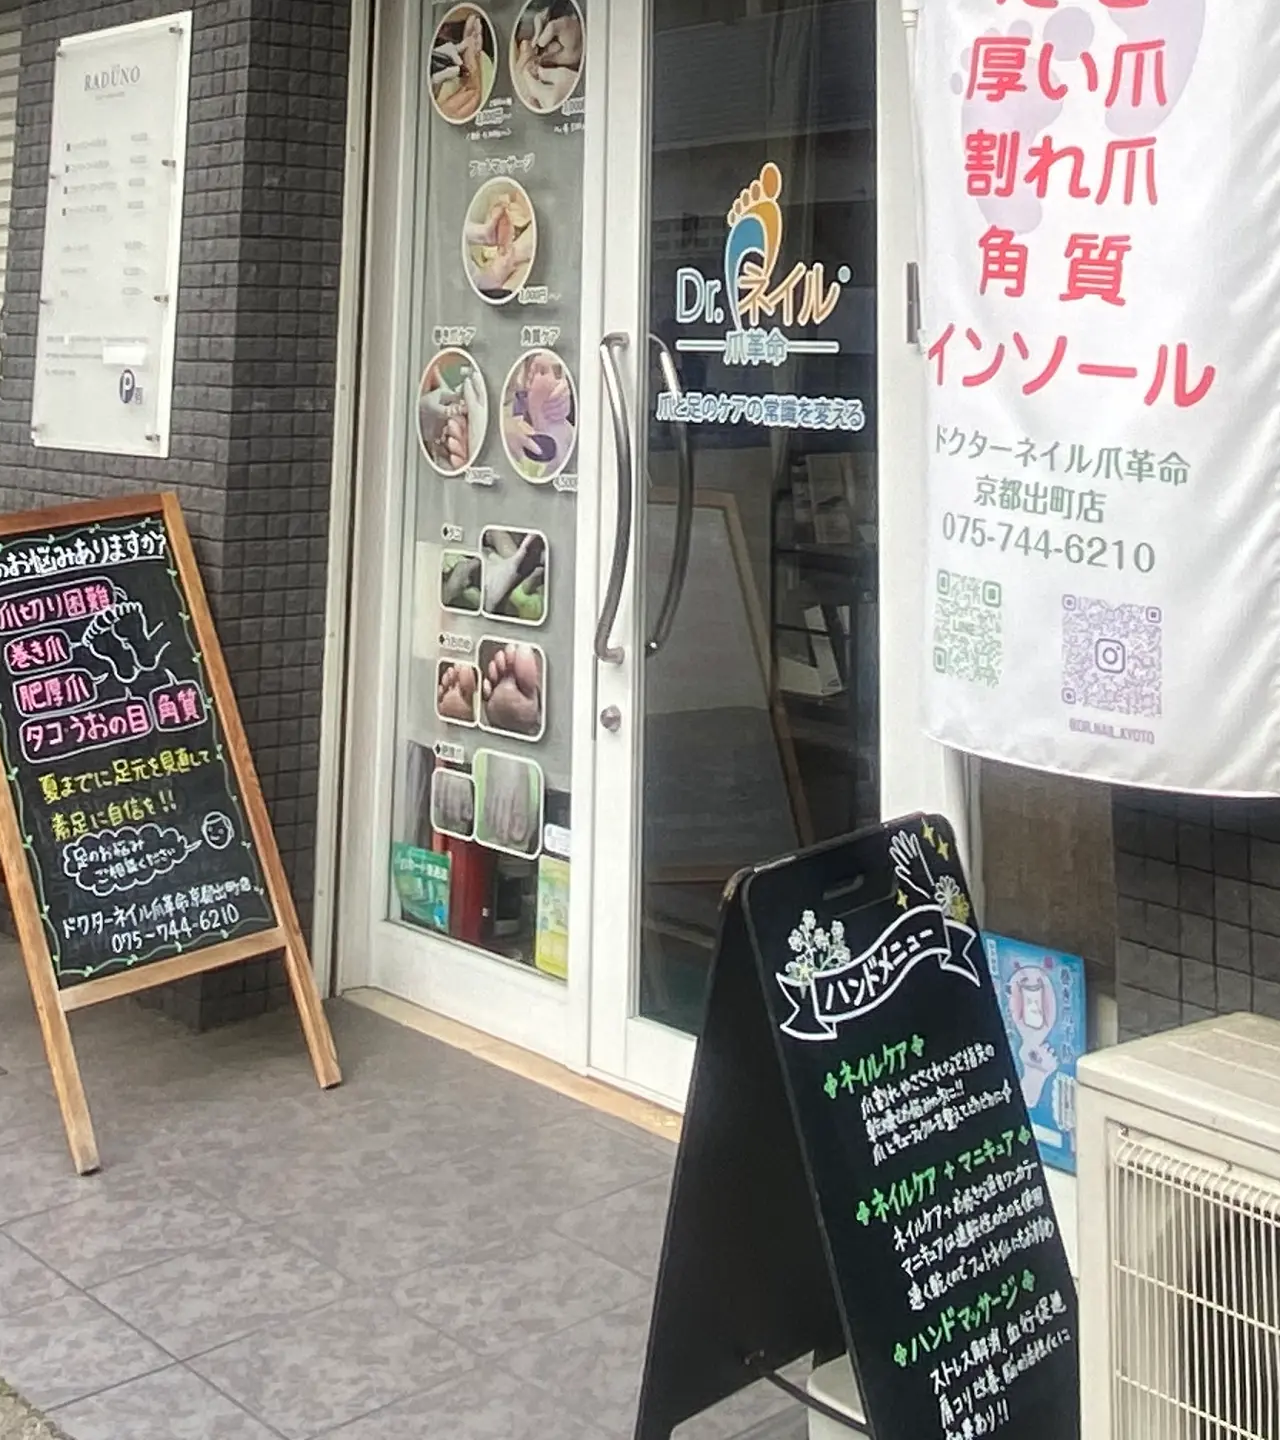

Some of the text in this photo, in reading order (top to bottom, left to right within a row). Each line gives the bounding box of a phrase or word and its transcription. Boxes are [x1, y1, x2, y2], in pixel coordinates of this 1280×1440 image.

[84, 64, 140, 91] RADÜNO
[966, 36, 1167, 108] 厚い爪
[964, 128, 1158, 206] 割れ爪
[723, 327, 789, 366] 爪革命
[927, 322, 1216, 408] インソール
[656, 391, 865, 432] 爪と足のケアの常識を変える
[935, 424, 1193, 487] ドクターネイル爪革命
[973, 474, 1108, 523] 京都出町店
[942, 512, 1156, 574] 075-744-6210
[10, 635, 67, 668] 巻き爪
[19, 673, 90, 712] 肥厚爪
[158, 687, 200, 725] 角質
[38, 747, 210, 805] 夏までに足元を見直して
[111, 903, 240, 954] 075-744-6210
[825, 928, 934, 1011] ハンドメニュー
[839, 1041, 908, 1094] ネイルケア
[958, 1130, 1014, 1173] マニキュア
[911, 1274, 1018, 1362] ハンドマッサージ
